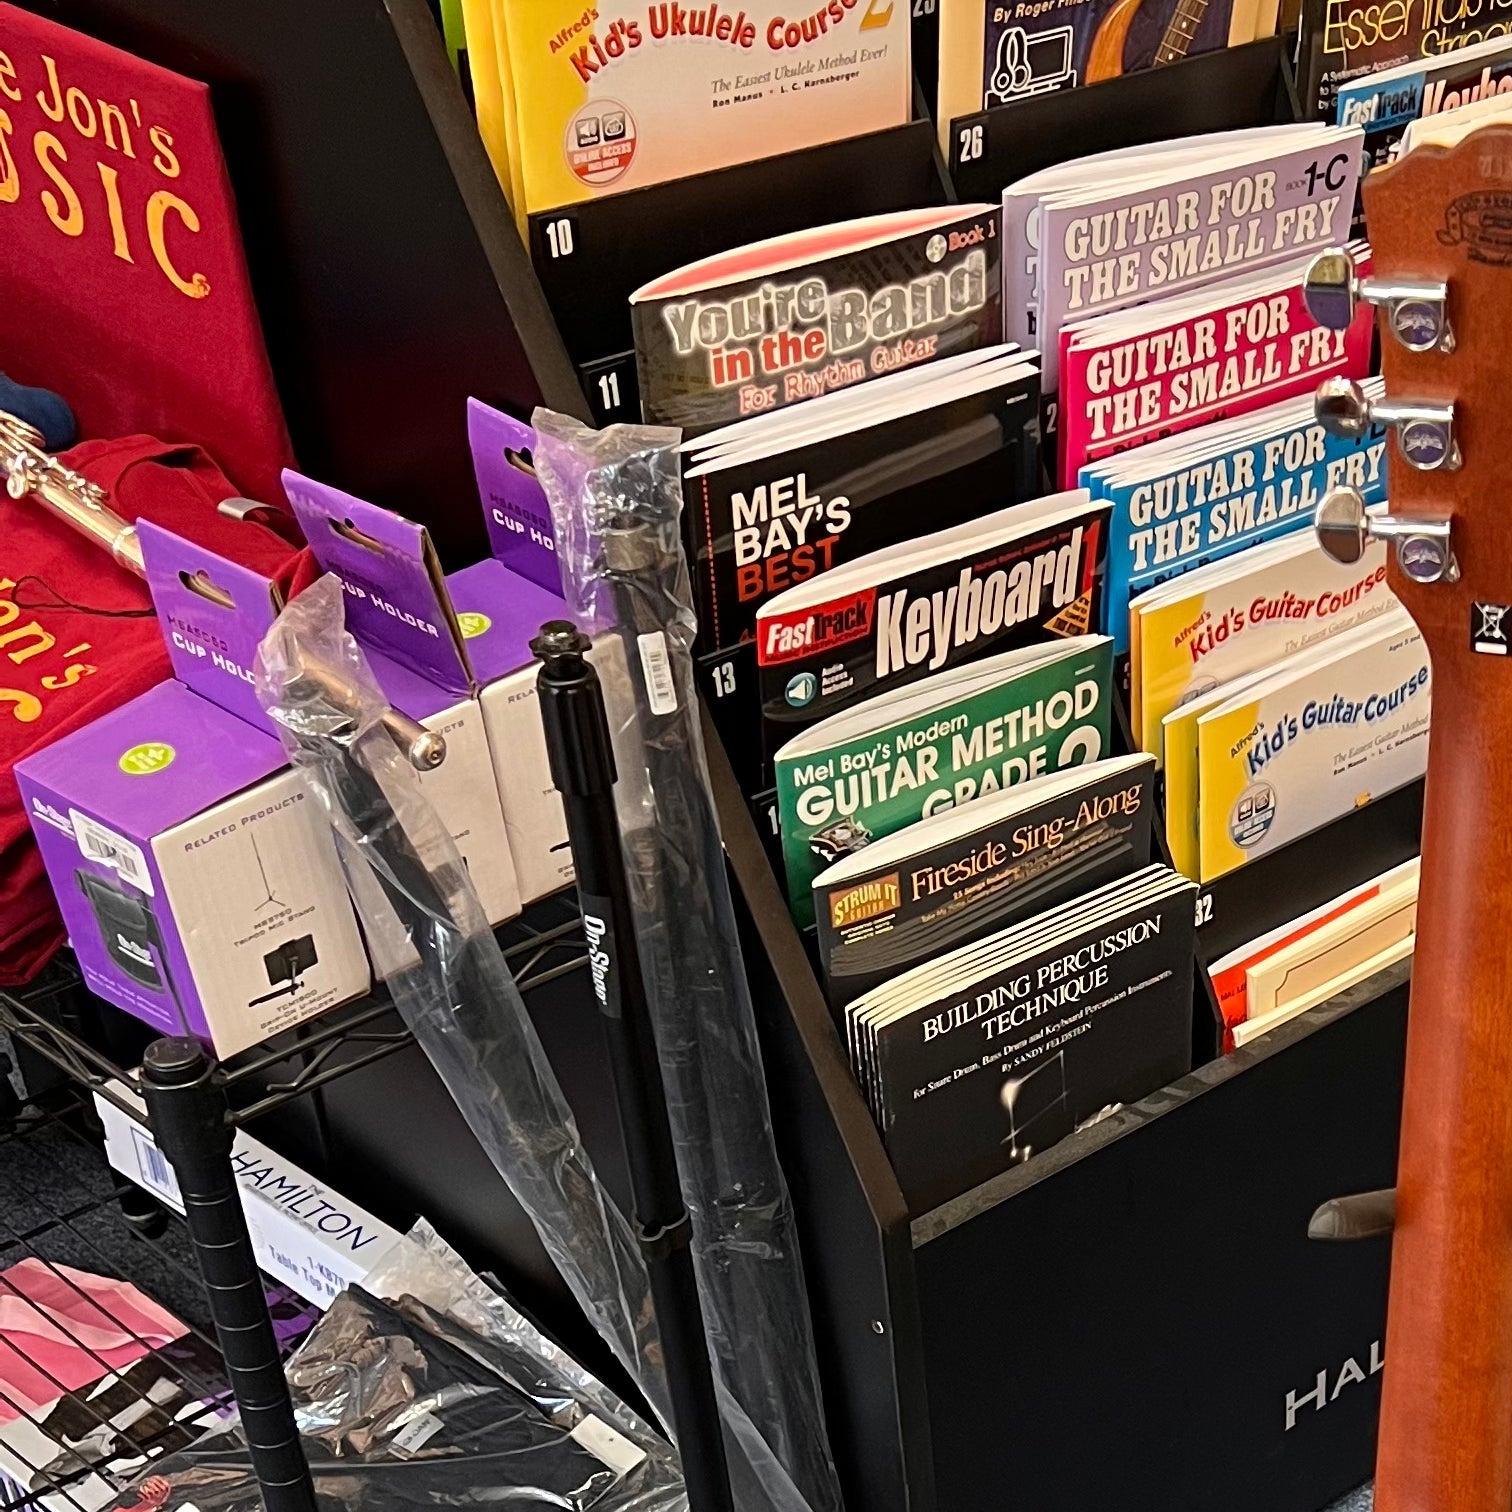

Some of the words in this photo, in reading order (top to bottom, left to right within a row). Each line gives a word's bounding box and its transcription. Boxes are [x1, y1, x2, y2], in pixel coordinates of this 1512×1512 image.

[549, 7, 599, 54] Alfred's
[994, 7, 1012, 24] By
[1015, 1, 1055, 18] Roger
[569, 18, 642, 83] Kid's
[649, 1, 756, 49] Ukulele
[712, 80, 732, 94] The
[735, 71, 772, 89] Easiest
[774, 62, 815, 81] Ukulele
[818, 50, 858, 72] Method
[36, 54, 180, 178] Jon's
[960, 126, 984, 164] 26
[1064, 180, 1200, 263] GUITAR
[1206, 171, 1277, 223] FOR
[1304, 153, 1349, 197] 1-C
[546, 219, 574, 258] 10
[948, 227, 984, 251] Book
[1064, 253, 1141, 309] THE
[1148, 223, 1265, 287] SMALL
[1272, 196, 1341, 246] FRY
[663, 279, 826, 356] You're
[828, 250, 986, 353] Band
[710, 347, 754, 386] in
[761, 328, 827, 376] the
[1086, 319, 1217, 395] GUITAR
[1224, 295, 1291, 353] FOR
[598, 372, 619, 410] 11
[739, 384, 776, 414] For
[785, 359, 865, 396] Rhythm
[870, 336, 938, 374] Guitar
[1086, 387, 1162, 441] THE
[1169, 351, 1283, 416] SMALL
[1288, 327, 1348, 380] FRY
[731, 473, 820, 531] MEL
[1129, 450, 1256, 528] GUITAR
[1262, 424, 1326, 482] FOR
[493, 508, 525, 534] CUP
[734, 496, 852, 567] BAY'S
[1129, 517, 1201, 572] THE
[1208, 481, 1319, 546] SMALL
[737, 534, 841, 602] BEST
[1316, 564, 1387, 617] Course
[341, 581, 366, 598] UP
[370, 594, 439, 638] HOLDER
[765, 599, 868, 655] FastTrack
[877, 526, 1084, 679] Keyboard
[1083, 519, 1101, 591] 1
[1249, 591, 1315, 625] Guitar
[172, 631, 206, 657] CUP
[1173, 611, 1211, 649] Alfred's
[1189, 608, 1245, 664] Kid's
[711, 661, 737, 698] 13
[1364, 665, 1428, 722] Course
[1229, 721, 1265, 759] Alfred's
[1301, 693, 1364, 730] Guitar
[793, 756, 834, 788] Mel
[841, 740, 891, 772] Bay's
[896, 713, 968, 754] Modern
[796, 746, 939, 827] GUITAR
[951, 679, 1100, 772] METHOD
[1246, 714, 1298, 777] Kid's
[184, 823, 236, 852] RELATED
[241, 793, 305, 826] PRODUCTS
[910, 841, 1008, 902] Fireside
[1011, 783, 1143, 855] Sing-Along
[834, 884, 881, 925] STRUM
[883, 884, 898, 907] IT
[1194, 894, 1213, 927] 32
[922, 975, 1031, 1042] BUILDING
[1036, 915, 1162, 992] PERCUSSION
[981, 965, 1109, 1040] TECHNIQUE
[982, 1051, 1002, 1067] Bass
[1045, 1009, 1084, 1037] Keyboard
[1014, 1046, 1045, 1067] SANDY
[1046, 1021, 1092, 1051] FELDSTEIN
[231, 1150, 377, 1251] HAMILTON
[268, 1244, 299, 1276] Table
